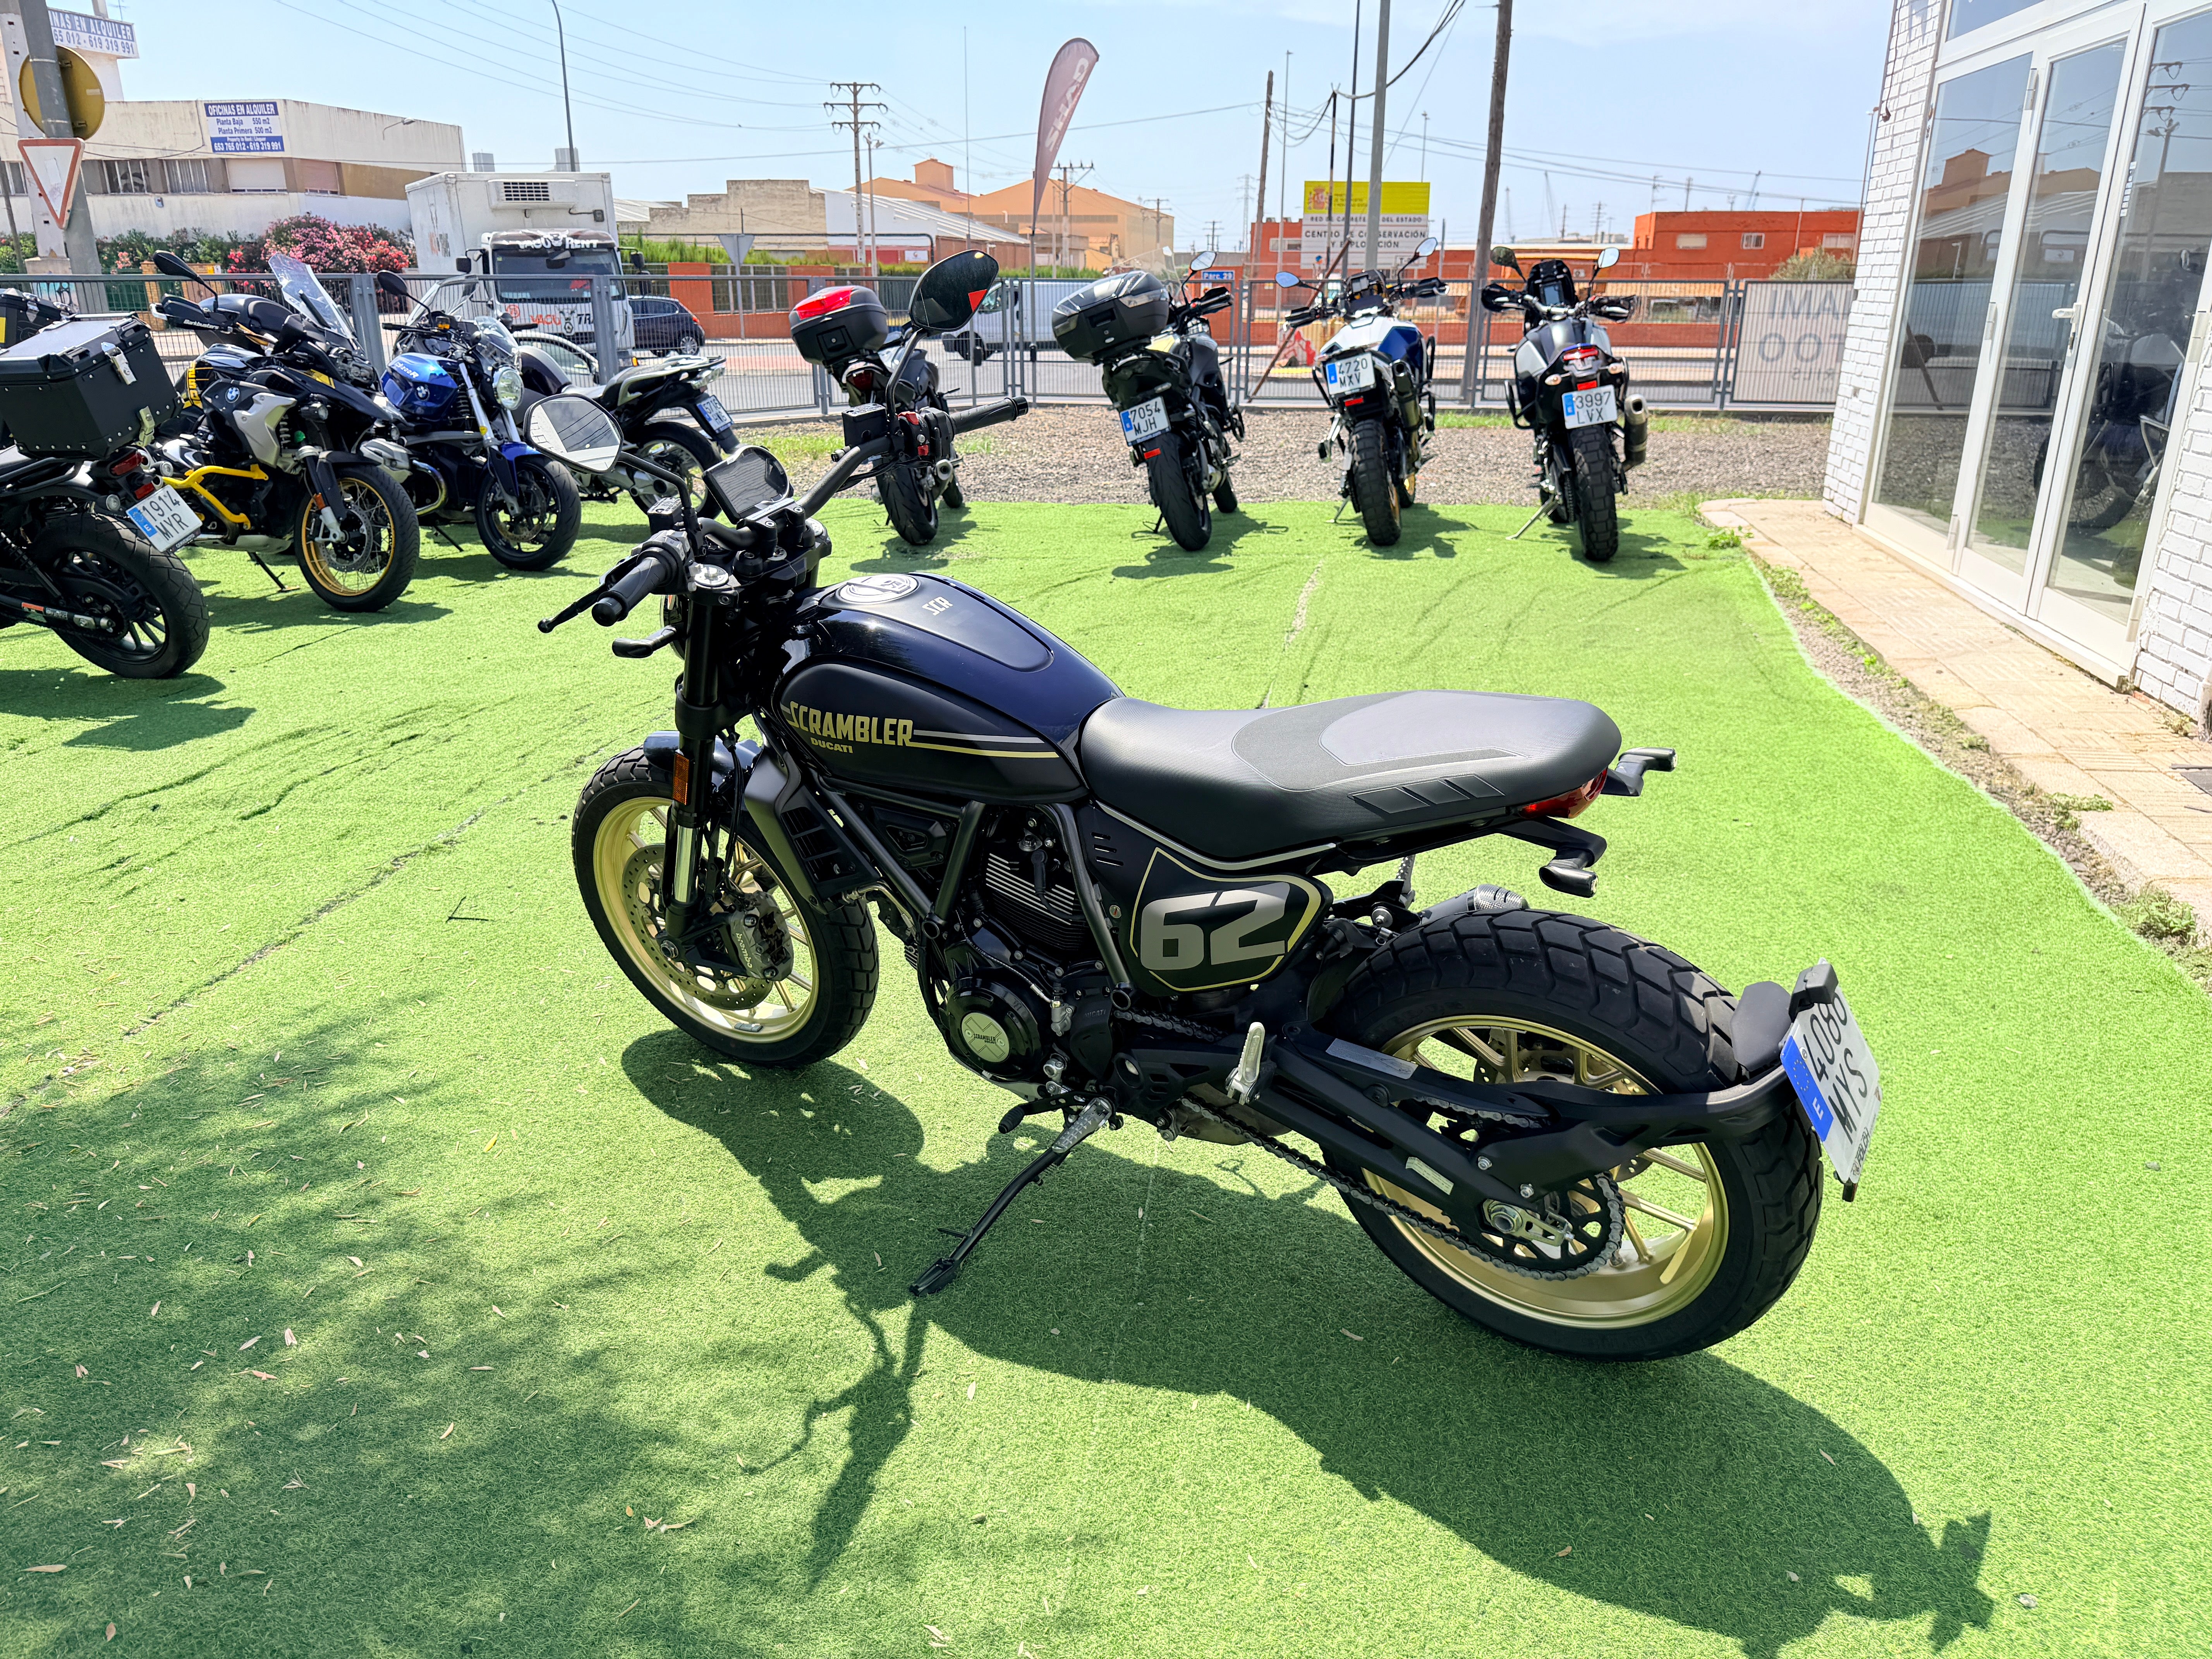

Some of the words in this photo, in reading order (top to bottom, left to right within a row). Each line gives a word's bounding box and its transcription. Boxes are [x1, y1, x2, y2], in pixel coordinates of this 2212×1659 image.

[48, 10, 72, 29] INAS
[74, 16, 87, 32] EN
[90, 19, 133, 40] ALQUILER
[53, 29, 64, 42] 65
[66, 31, 81, 45] 012
[89, 35, 102, 49] 619
[105, 39, 119, 52] 319
[121, 41, 135, 54] 991
[208, 104, 236, 116] OFICINAS
[236, 104, 246, 115] EN
[246, 104, 275, 115] ALQUILER
[233, 118, 243, 126] Baja
[214, 143, 224, 151] 653
[225, 142, 235, 151] 765
[235, 142, 246, 151] 012
[249, 142, 260, 150] 619
[260, 141, 271, 150] 319
[271, 141, 282, 150] 991
[565, 237, 599, 249] RENT
[1339, 358, 1368, 374] 4720
[1339, 372, 1360, 388] MXV
[1575, 391, 1611, 409] 3997
[1130, 401, 1161, 422] 7054
[1577, 407, 1604, 424] LVX
[1133, 417, 1157, 436] MJH
[142, 490, 180, 521] 1914
[144, 524, 152, 532] E
[155, 513, 189, 541] MYR
[922, 596, 953, 616] SCR
[787, 701, 913, 746] SCRAMBLER
[811, 737, 853, 753] DUCATI
[1140, 881, 1290, 970] 62
[735, 933, 752, 968] brembo
[973, 1033, 996, 1043] SCRAMBLER
[1803, 992, 1847, 1082] 4080
[1828, 1048, 1867, 1145] MYS
[1812, 1097, 1824, 1121] E
